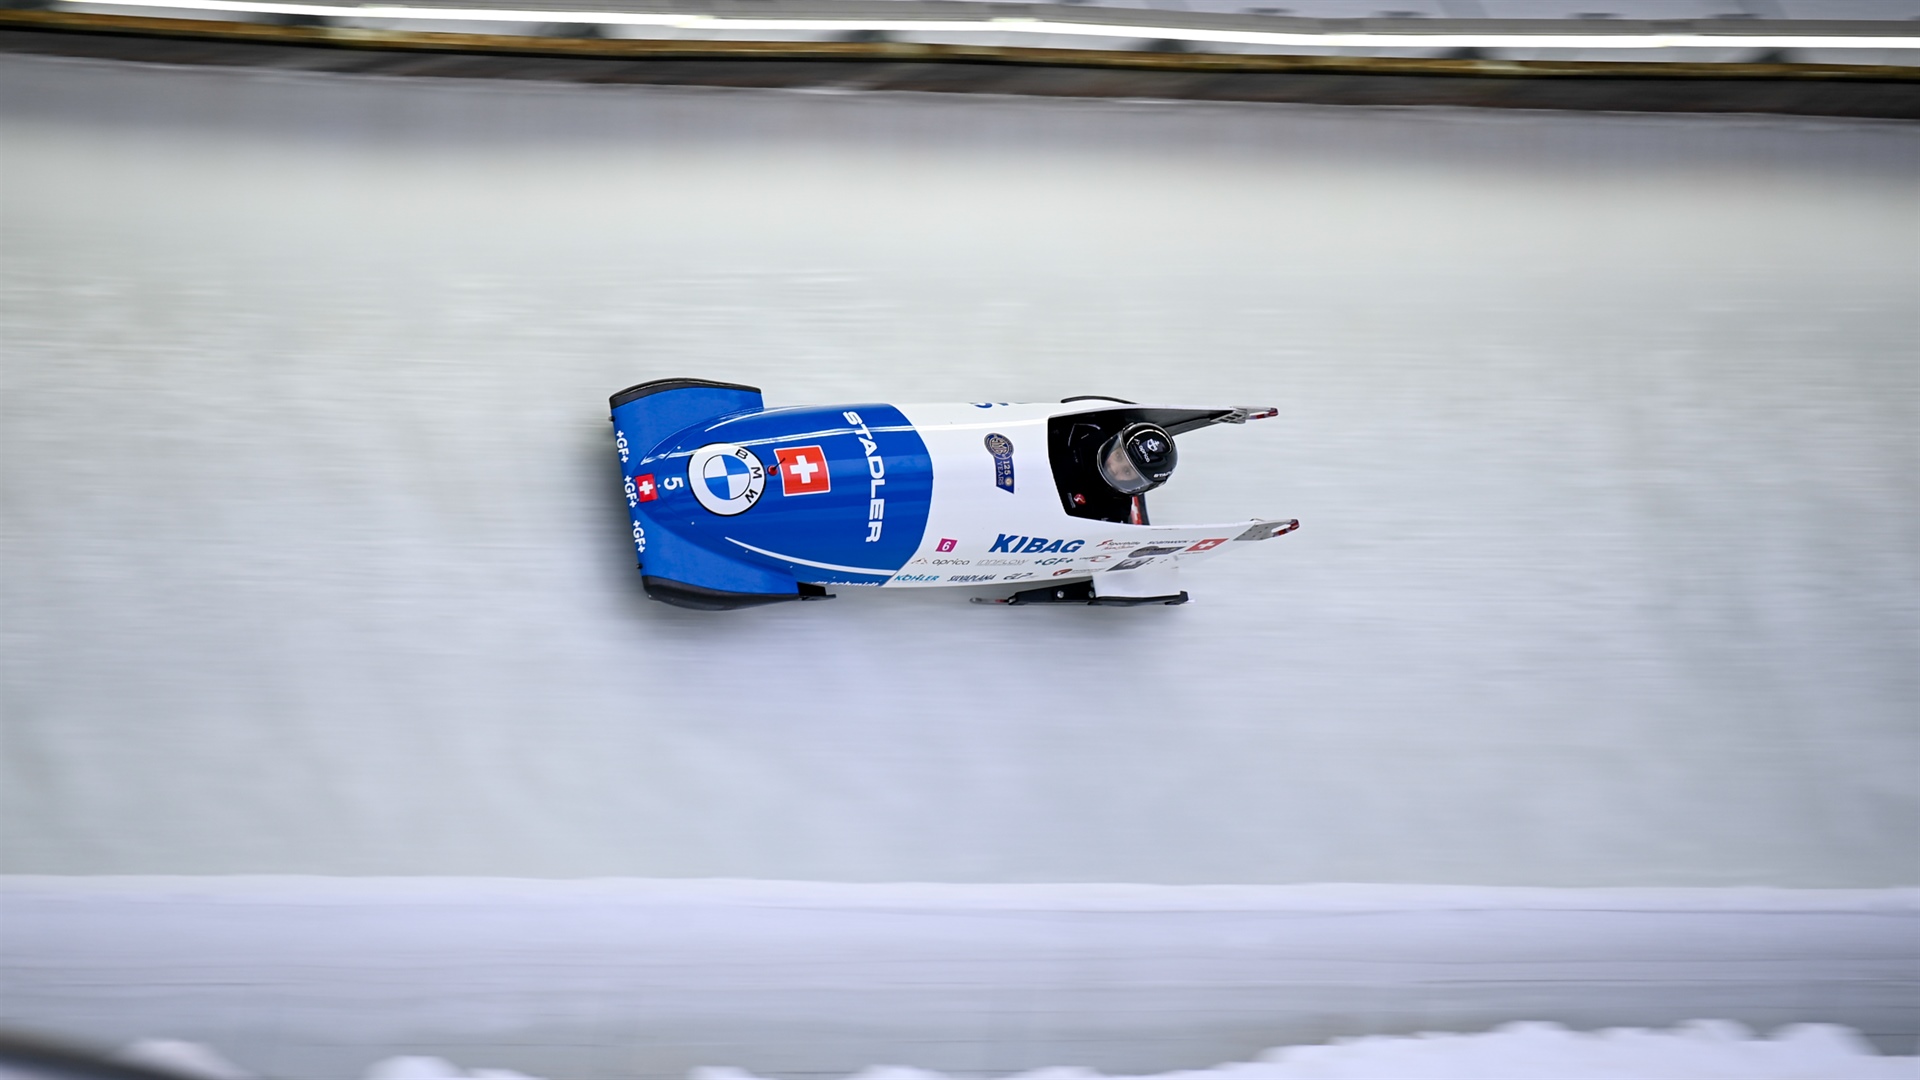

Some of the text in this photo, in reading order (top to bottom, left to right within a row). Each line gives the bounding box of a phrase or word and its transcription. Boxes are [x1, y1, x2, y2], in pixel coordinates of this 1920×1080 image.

[735, 449, 762, 503] BMW
[842, 411, 885, 542] STADLER
[1004, 461, 1012, 475] 125
[663, 476, 684, 490] 5
[941, 541, 951, 551] 6
[988, 533, 1085, 553] KIBAG
